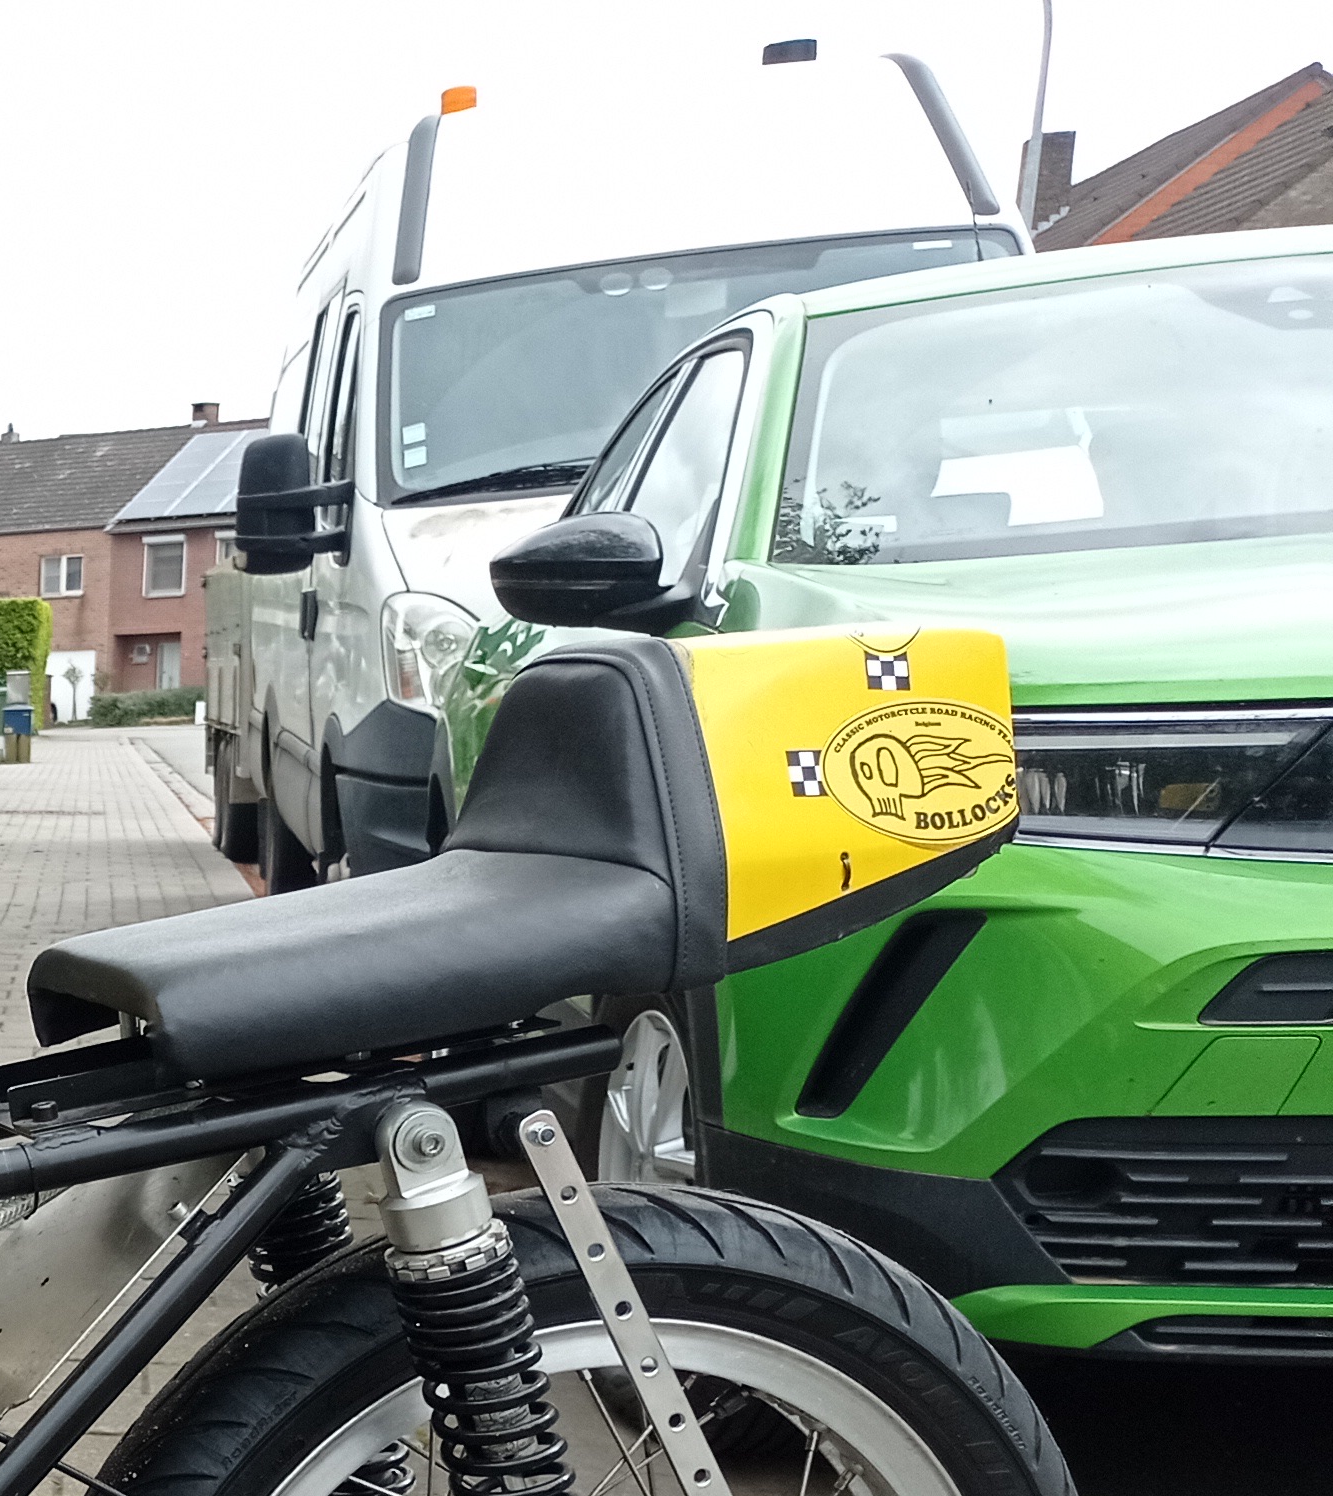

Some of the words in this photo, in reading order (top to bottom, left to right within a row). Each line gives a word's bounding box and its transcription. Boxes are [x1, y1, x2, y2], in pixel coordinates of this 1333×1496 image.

[834, 722, 865, 753] CLASSIC
[865, 707, 928, 728] MOTORCYCLE
[929, 707, 958, 717] ROAD
[960, 711, 996, 731] RACING
[914, 773, 1016, 830] BOLLOCKS
